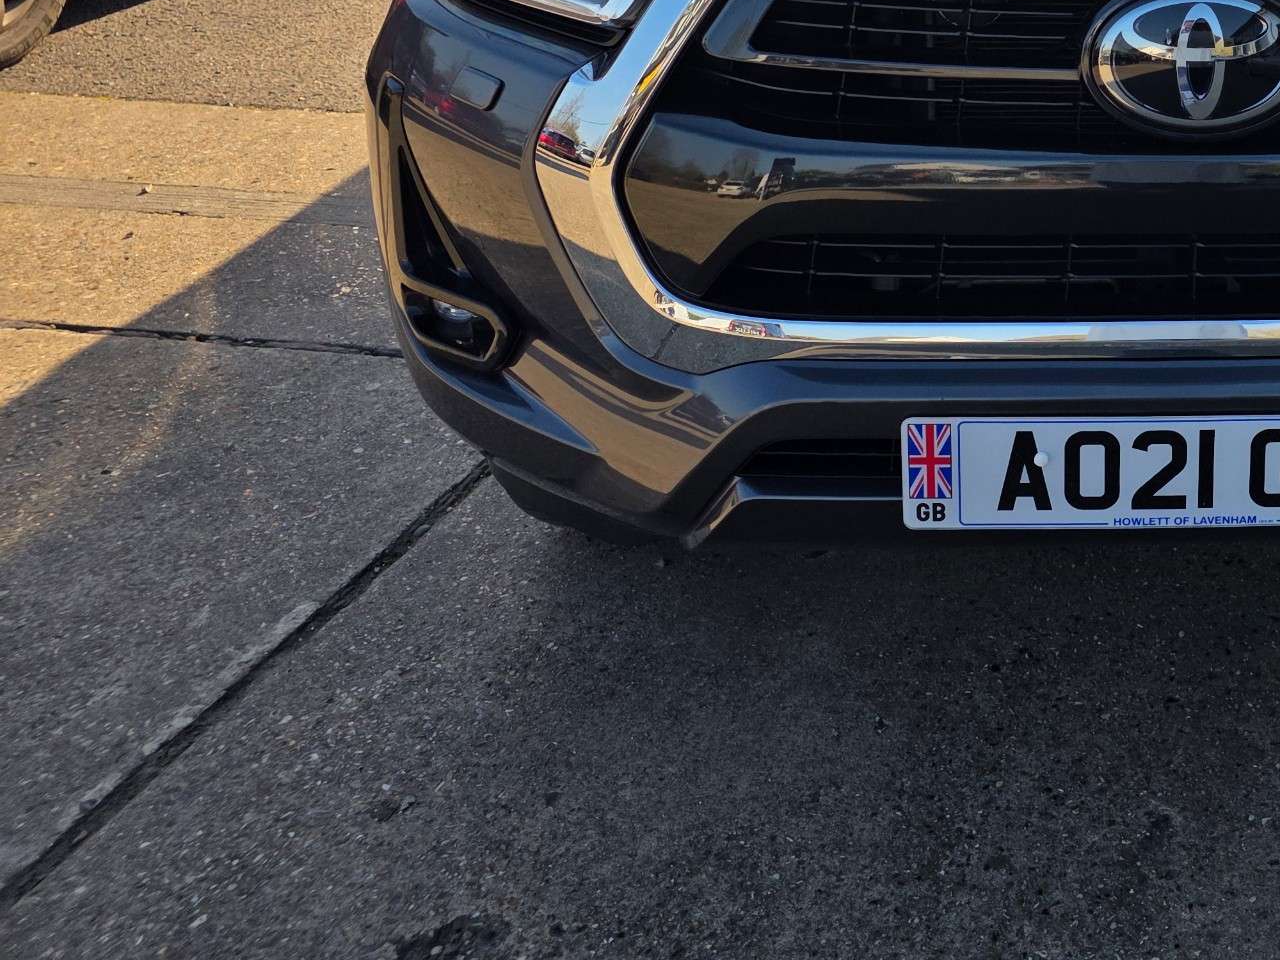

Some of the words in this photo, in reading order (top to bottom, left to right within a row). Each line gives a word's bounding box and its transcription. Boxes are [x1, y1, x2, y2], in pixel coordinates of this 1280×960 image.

[997, 429, 1216, 512] AO21
[916, 502, 946, 522] GB
[1113, 516, 1171, 526] HOWLETT
[1174, 516, 1190, 525] OF
[1193, 515, 1257, 525] LAVENHAM
